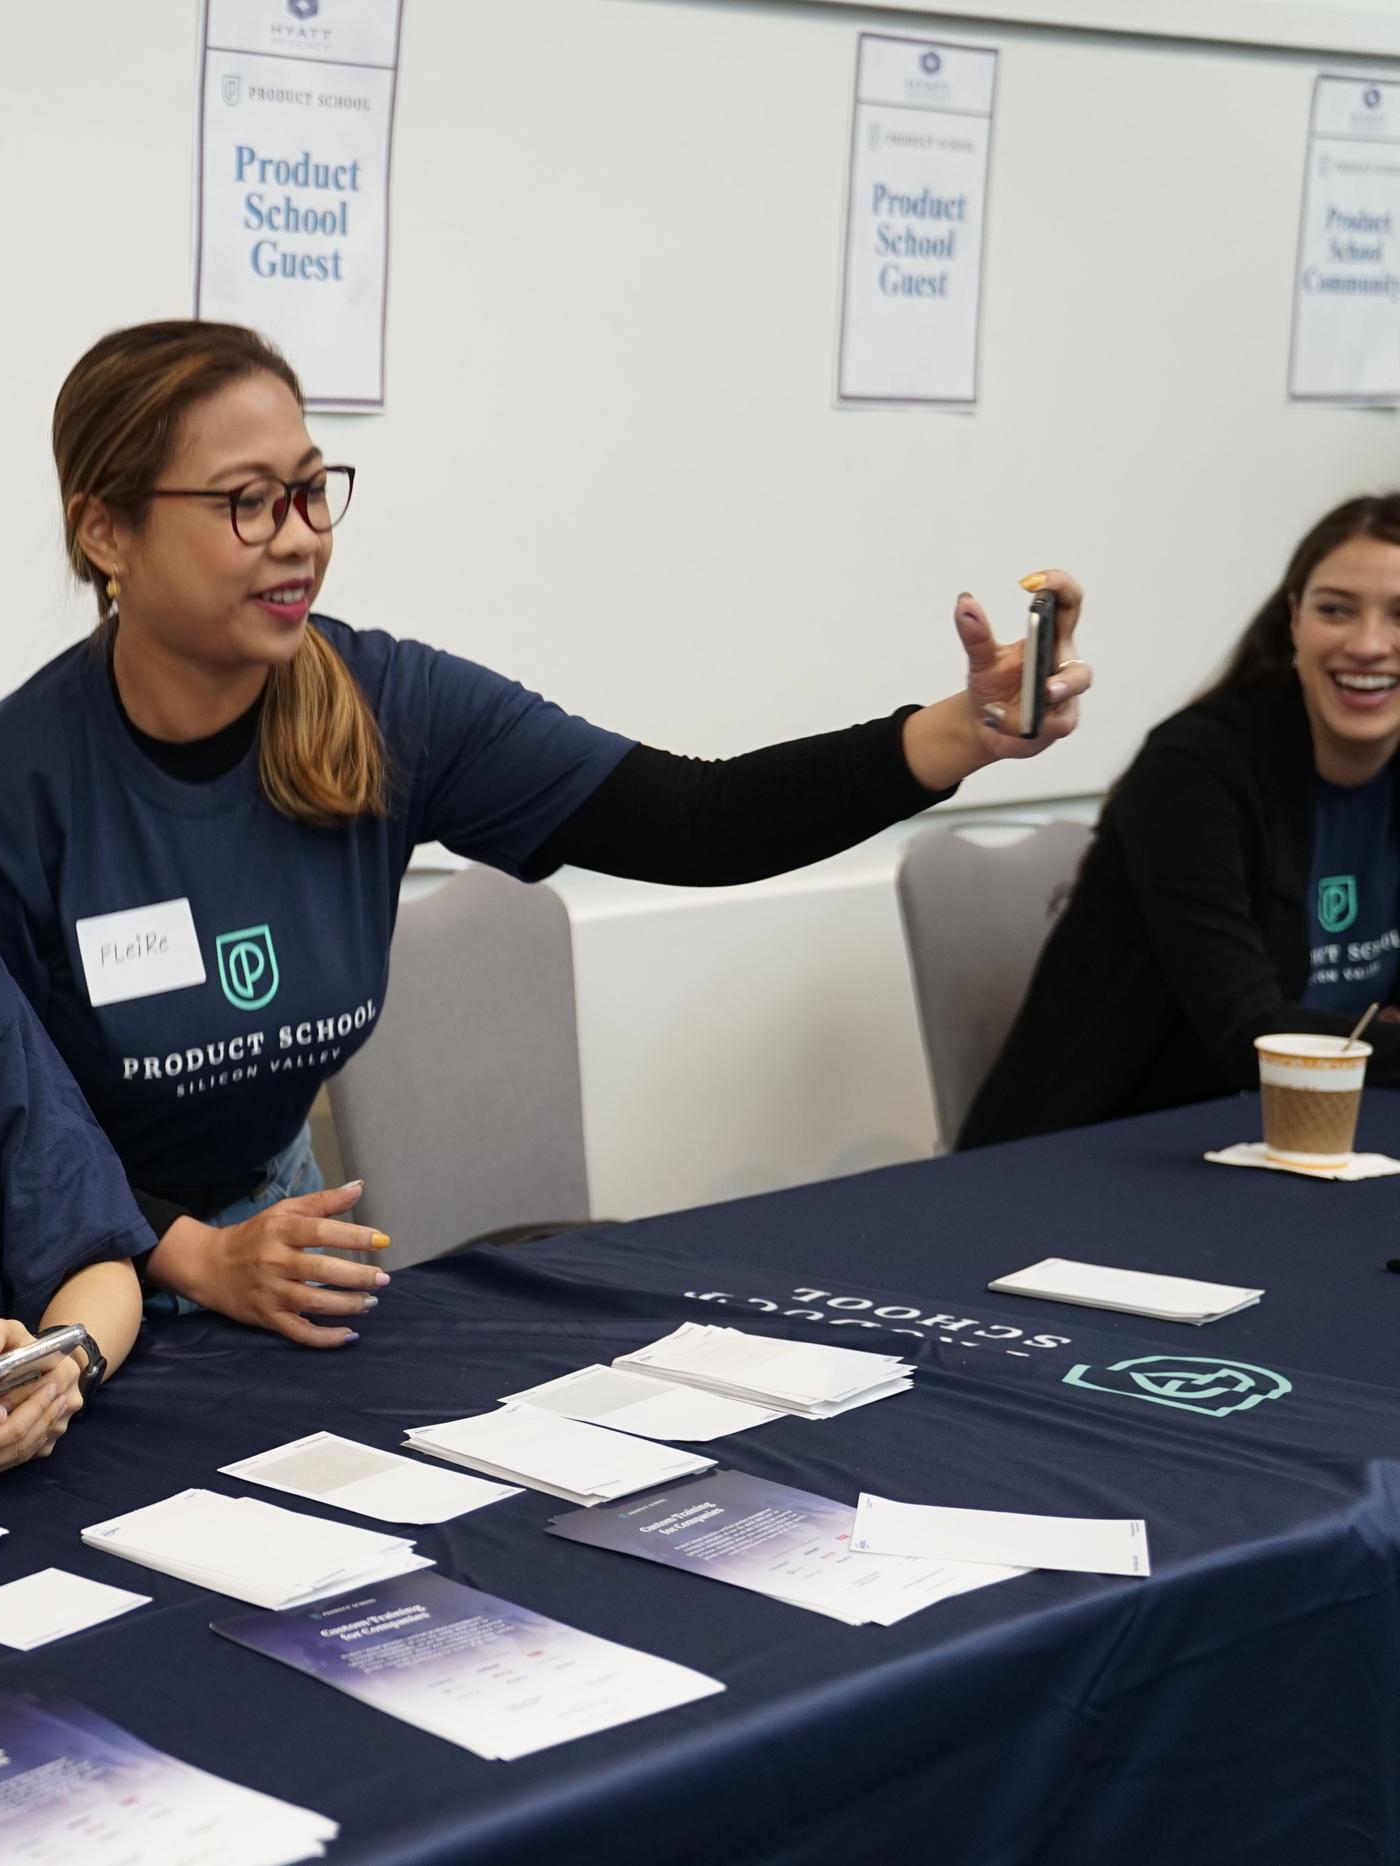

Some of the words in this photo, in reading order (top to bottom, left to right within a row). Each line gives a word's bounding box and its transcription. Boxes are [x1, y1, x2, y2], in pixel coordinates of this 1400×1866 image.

[270, 24, 333, 41] HYATT
[248, 86, 312, 106] PRODUCT
[316, 90, 371, 112] SCHOOL
[233, 144, 362, 192] Product
[243, 191, 349, 237] School
[871, 181, 968, 222] Product
[249, 239, 344, 281] Guest
[875, 223, 956, 261] School
[877, 262, 950, 300] Guest
[122, 1031, 265, 1080] PRODUCT
[279, 998, 377, 1050] SCHOOL
[176, 1062, 259, 1098] SILICON
[269, 1046, 342, 1074] VALLEY
[791, 1287, 1073, 1350] SCHOOL
[670, 1501, 717, 1519] Training
